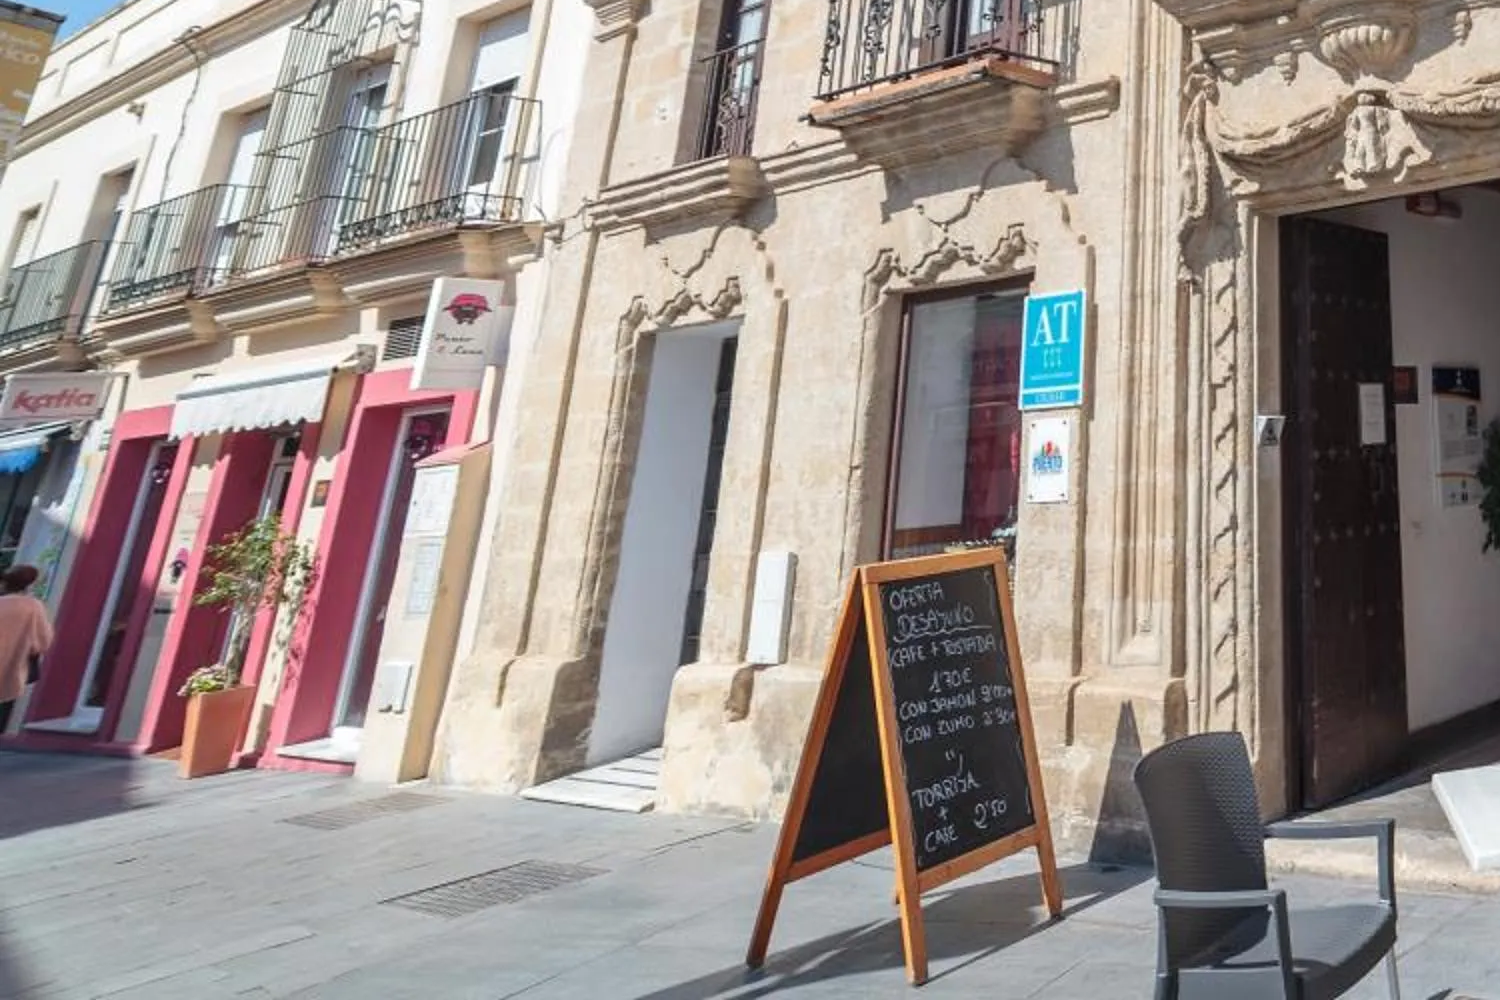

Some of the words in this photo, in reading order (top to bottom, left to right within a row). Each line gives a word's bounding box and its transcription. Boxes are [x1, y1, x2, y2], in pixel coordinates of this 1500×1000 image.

[1030, 301, 1076, 347] AT
[12, 389, 96, 413] katia
[889, 581, 944, 611] OFERTA
[900, 700, 928, 720] CON
[904, 725, 931, 744] CON
[912, 769, 980, 808] TORRIJA
